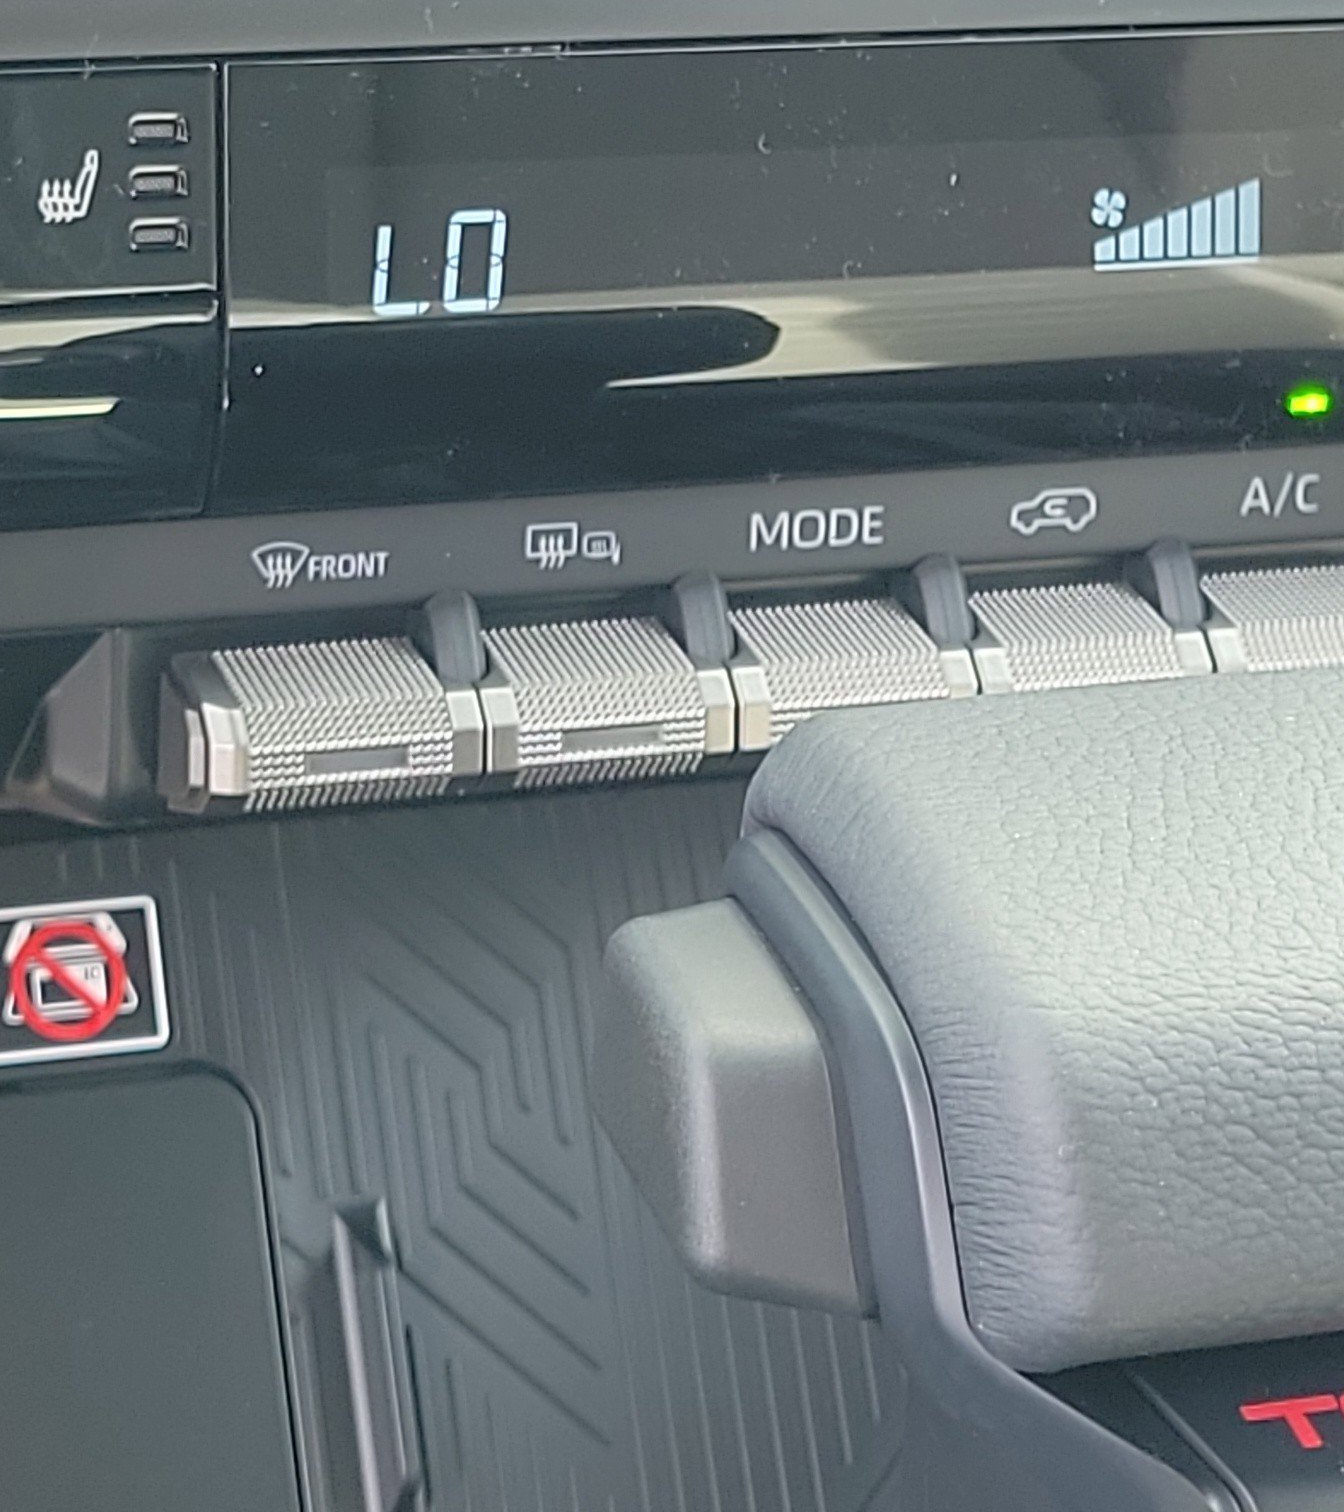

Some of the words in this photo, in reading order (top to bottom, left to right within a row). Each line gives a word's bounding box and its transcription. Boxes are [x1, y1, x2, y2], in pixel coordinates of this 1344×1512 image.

[1239, 472, 1321, 518] A/C
[748, 505, 885, 551] MODE
[307, 550, 390, 582] FRONT
